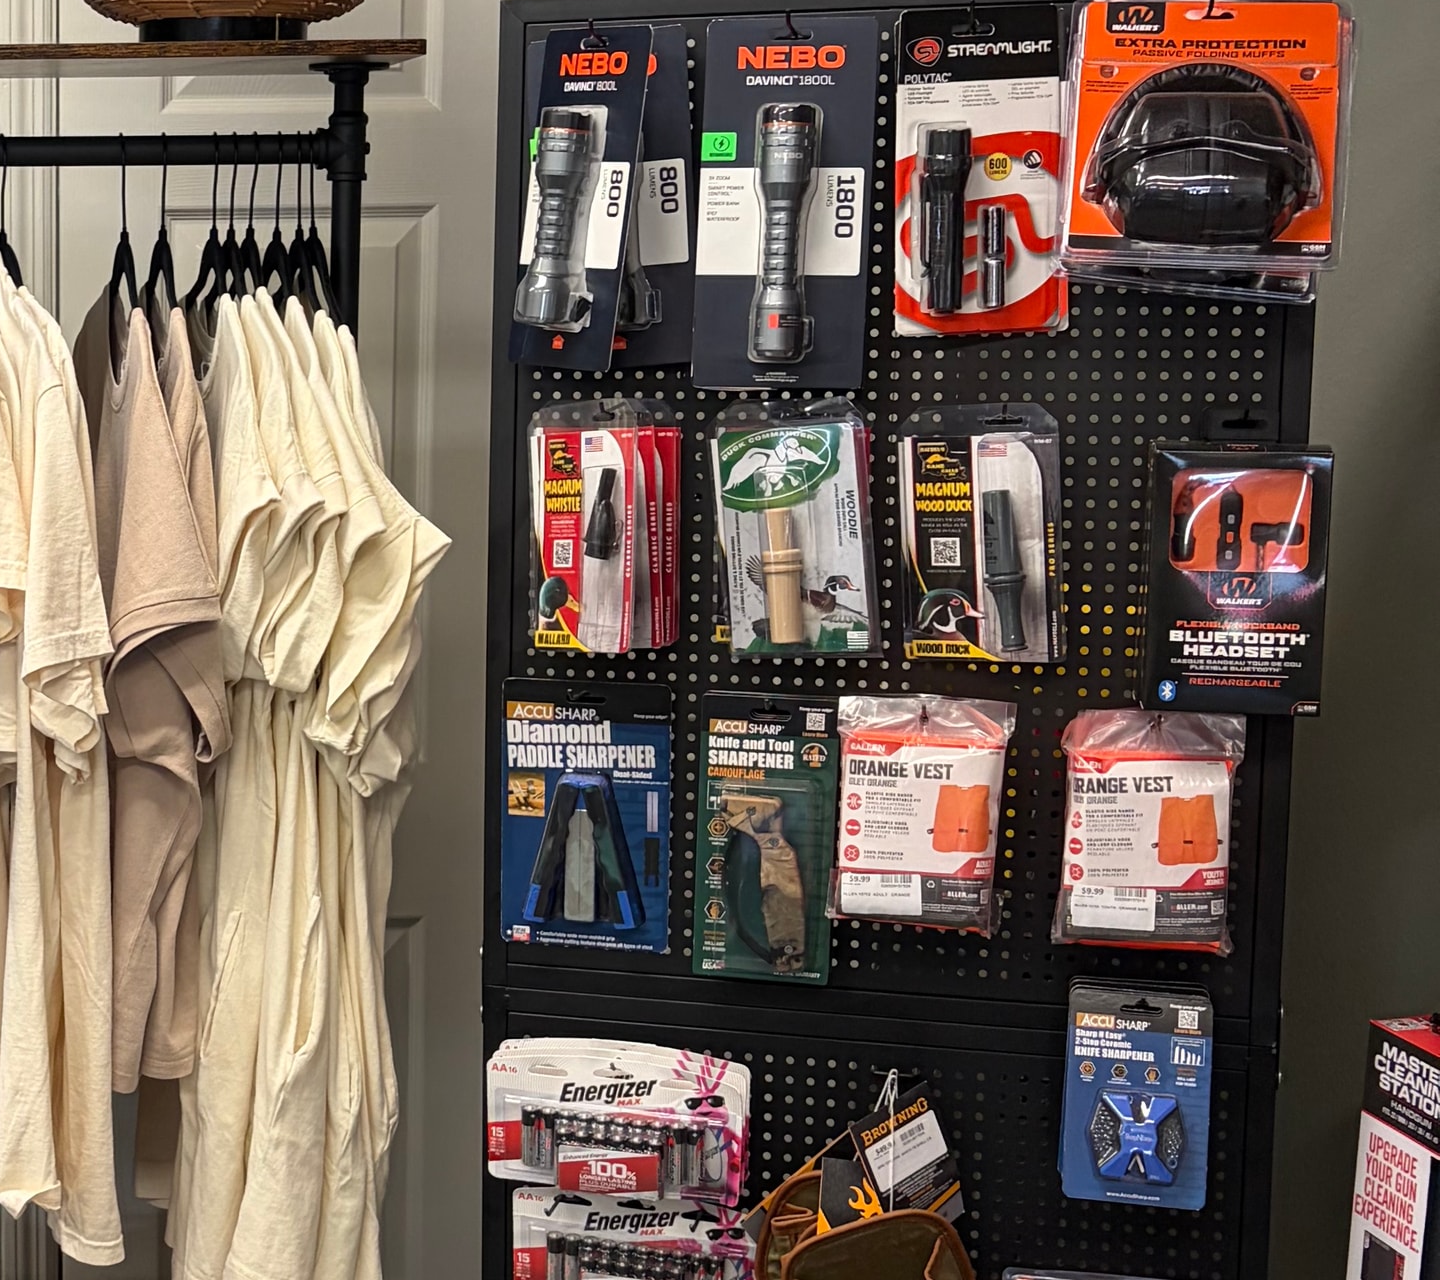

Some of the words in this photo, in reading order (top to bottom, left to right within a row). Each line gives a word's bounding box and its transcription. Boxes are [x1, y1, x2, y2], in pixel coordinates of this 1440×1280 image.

[1112, 24, 1160, 32] WALKER'S
[1115, 38, 1177, 49] EXTRA
[1182, 39, 1307, 49] PROTECTION
[737, 45, 845, 70] NEBO
[1133, 50, 1182, 58] PASSIVE
[1186, 50, 1238, 58] FOLDING
[560, 51, 629, 77] NEBO
[989, 158, 1007, 169] 600
[607, 170, 623, 217] 800
[660, 167, 678, 214] 800
[826, 175, 834, 207] LUMENS
[835, 175, 855, 238] 1800
[721, 442, 746, 461] DUCK
[544, 479, 582, 495] MAGNUM
[915, 482, 970, 497] MAGNUM
[546, 497, 580, 513] WHISTLE
[915, 500, 944, 512] WOOD
[946, 500, 972, 511] DUCK
[846, 489, 858, 540] WOODIE
[1048, 558, 1056, 576] PRO
[538, 633, 571, 645] MALLARD
[916, 643, 943, 654] WOOD
[945, 644, 970, 654] DUCK
[1183, 645, 1290, 659] HEADSET
[1189, 678, 1282, 687] RECHARGEABLE
[507, 720, 611, 744] Diamond
[709, 735, 740, 748] Knife
[742, 738, 764, 750] and
[766, 739, 794, 752] Tool
[508, 745, 563, 767] PADDLE
[565, 746, 656, 769] SHARPENER
[708, 750, 794, 770] SHARPENER
[708, 767, 765, 780] CAMOUFLAGE
[849, 759, 908, 778] ORANGE
[914, 764, 953, 780] VEST
[1132, 776, 1173, 792] VEST
[1086, 796, 1118, 804] ORANGE
[1075, 1037, 1099, 1046] 2-Step
[1100, 1040, 1132, 1049] Ceramic
[1074, 1046, 1101, 1057] KNIFE
[1102, 1049, 1154, 1062] SHARPENER
[560, 1079, 657, 1104] Energizer
[861, 1097, 928, 1146] BROWNING
[1390, 1100, 1432, 1130] HANDGUN
[491, 1126, 504, 1136] 15
[1369, 1132, 1418, 1179] UPGRADE
[587, 1161, 636, 1180] 100%
[1366, 1152, 1392, 1187] YOUR
[1395, 1173, 1418, 1203] GUN
[598, 1180, 636, 1190] DURABLE
[608, 1177, 636, 1185] LASTING
[1364, 1177, 1414, 1225] CLEANING
[584, 1211, 679, 1234] Energizer
[1355, 1193, 1419, 1254] EXPERIENCE.
[517, 1252, 530, 1263] 15
